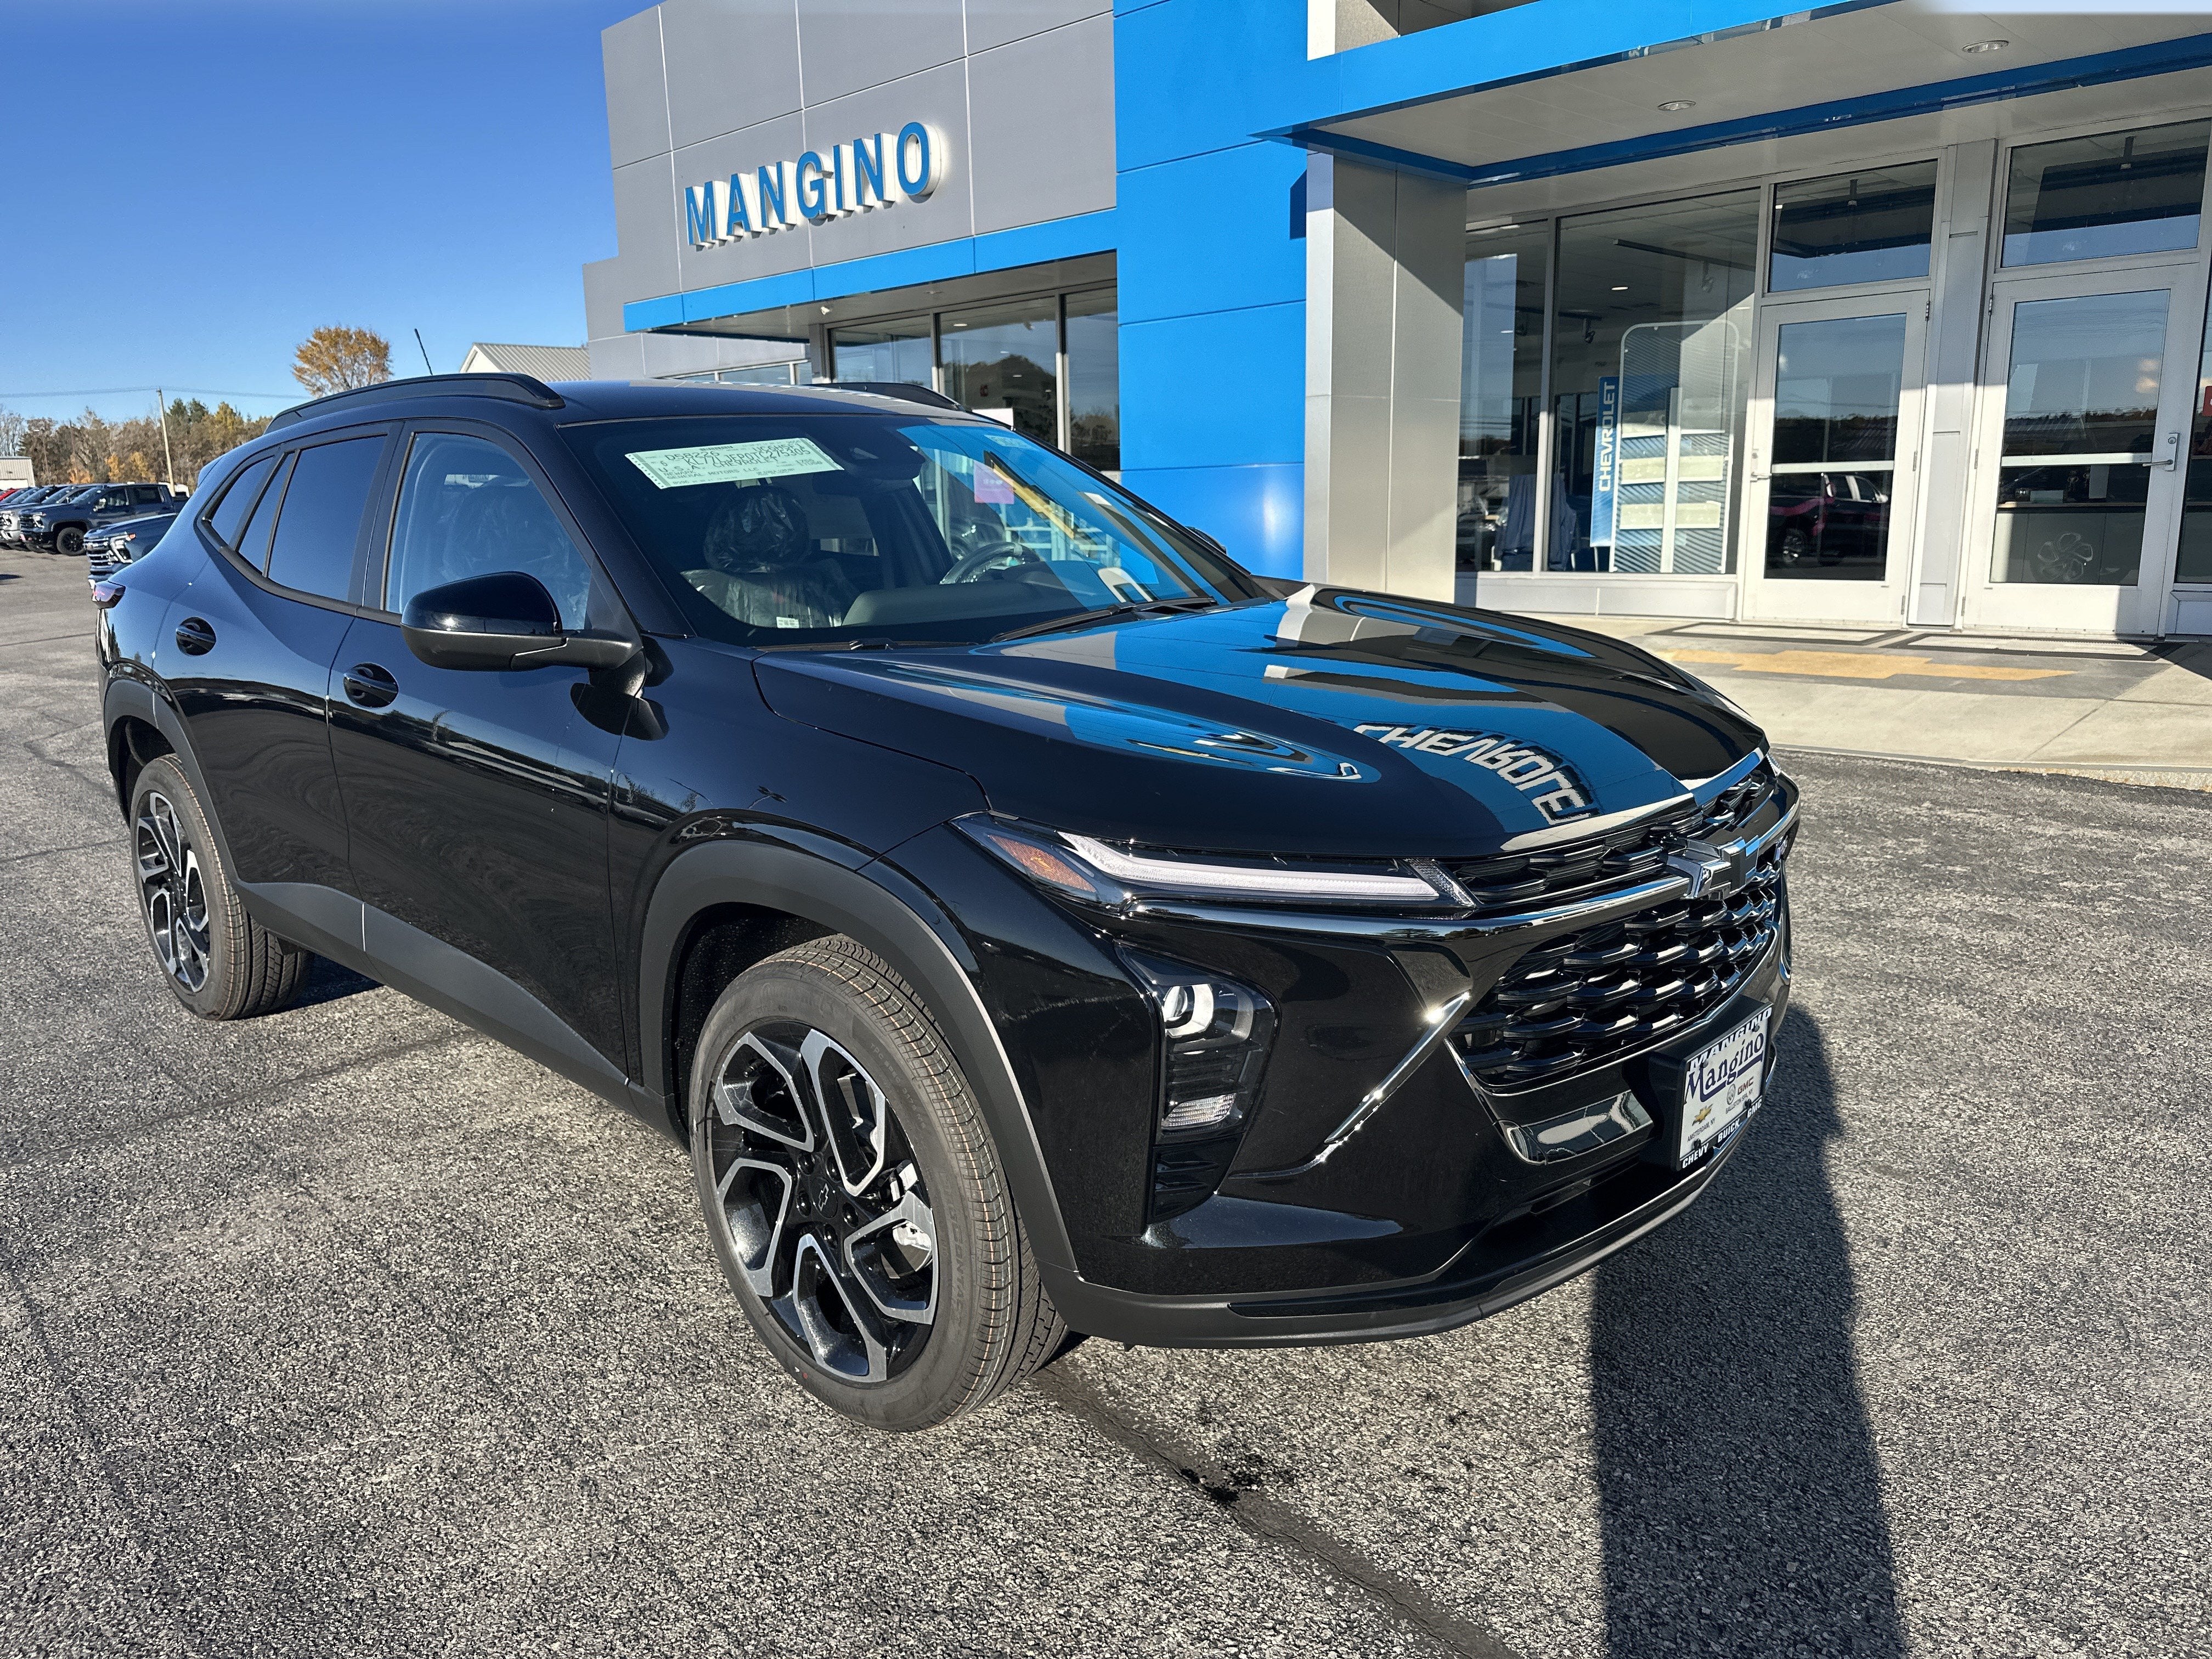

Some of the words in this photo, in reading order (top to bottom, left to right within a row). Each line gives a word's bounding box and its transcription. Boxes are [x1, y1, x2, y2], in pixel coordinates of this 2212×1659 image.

[685, 121, 936, 247] MANGINO
[664, 451, 719, 460] D58226
[713, 456, 778, 468] CHEVROLET
[1599, 382, 1615, 492] CHEVROLET
[1684, 1032, 1764, 1102] Mangino
[1737, 1076, 1754, 1095] GMC
[1682, 1143, 1709, 1169] CHEVY
[1718, 1118, 1742, 1143] BUICK
[1747, 1098, 1762, 1118] GMC
